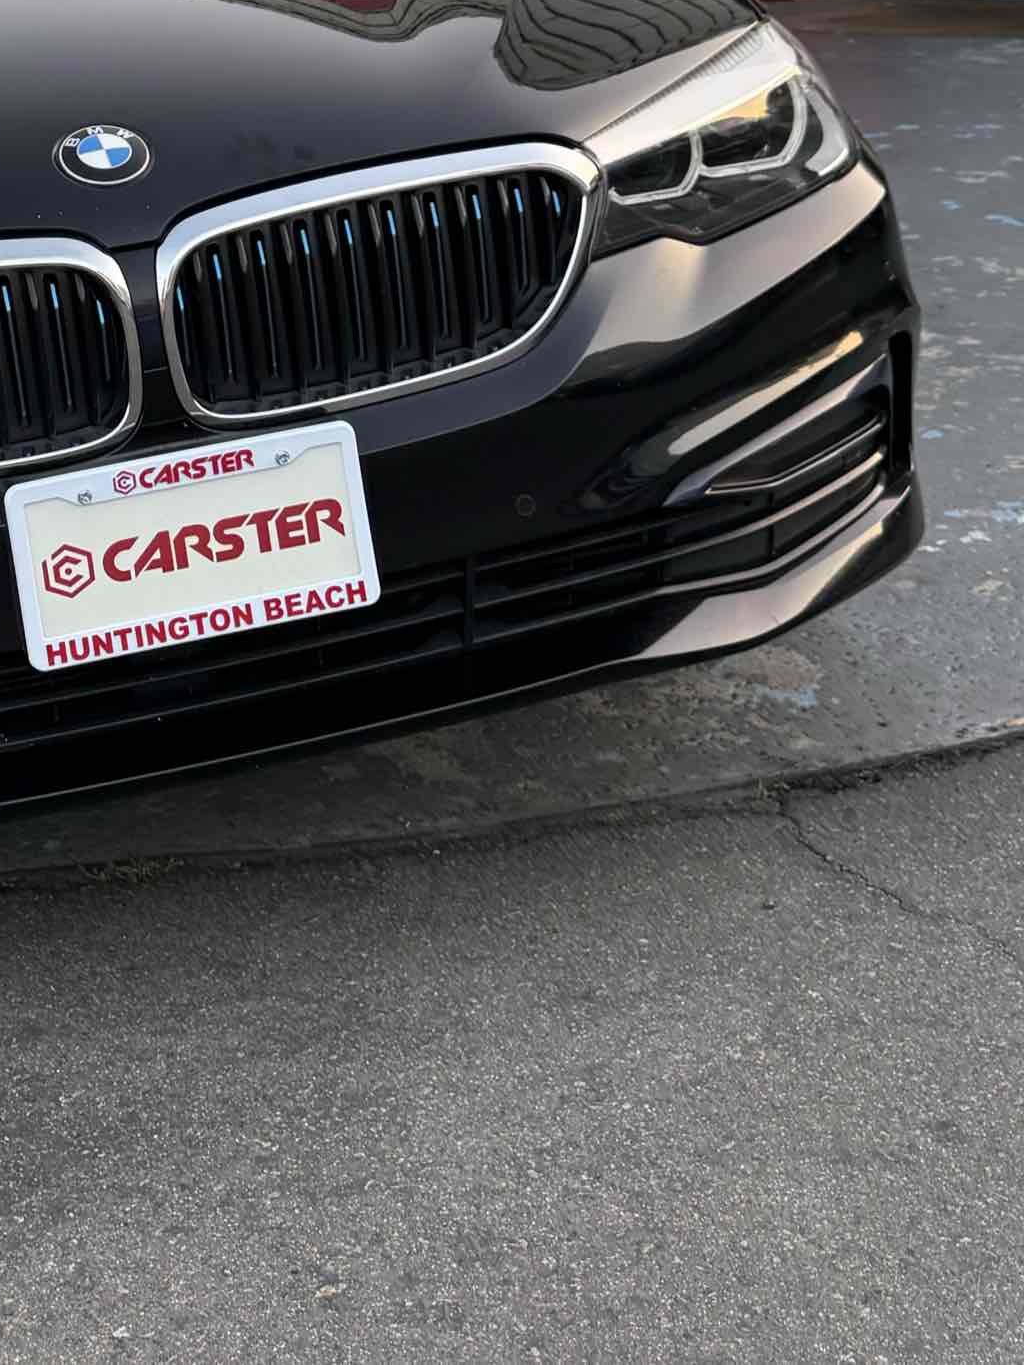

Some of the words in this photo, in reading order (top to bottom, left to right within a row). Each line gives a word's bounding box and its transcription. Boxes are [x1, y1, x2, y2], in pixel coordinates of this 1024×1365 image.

[67, 126, 134, 147] BMW
[139, 449, 255, 489] CARSTER
[102, 498, 346, 582] CARSTER
[46, 604, 254, 667] HUNTINGTON
[264, 580, 368, 619] BEACH
